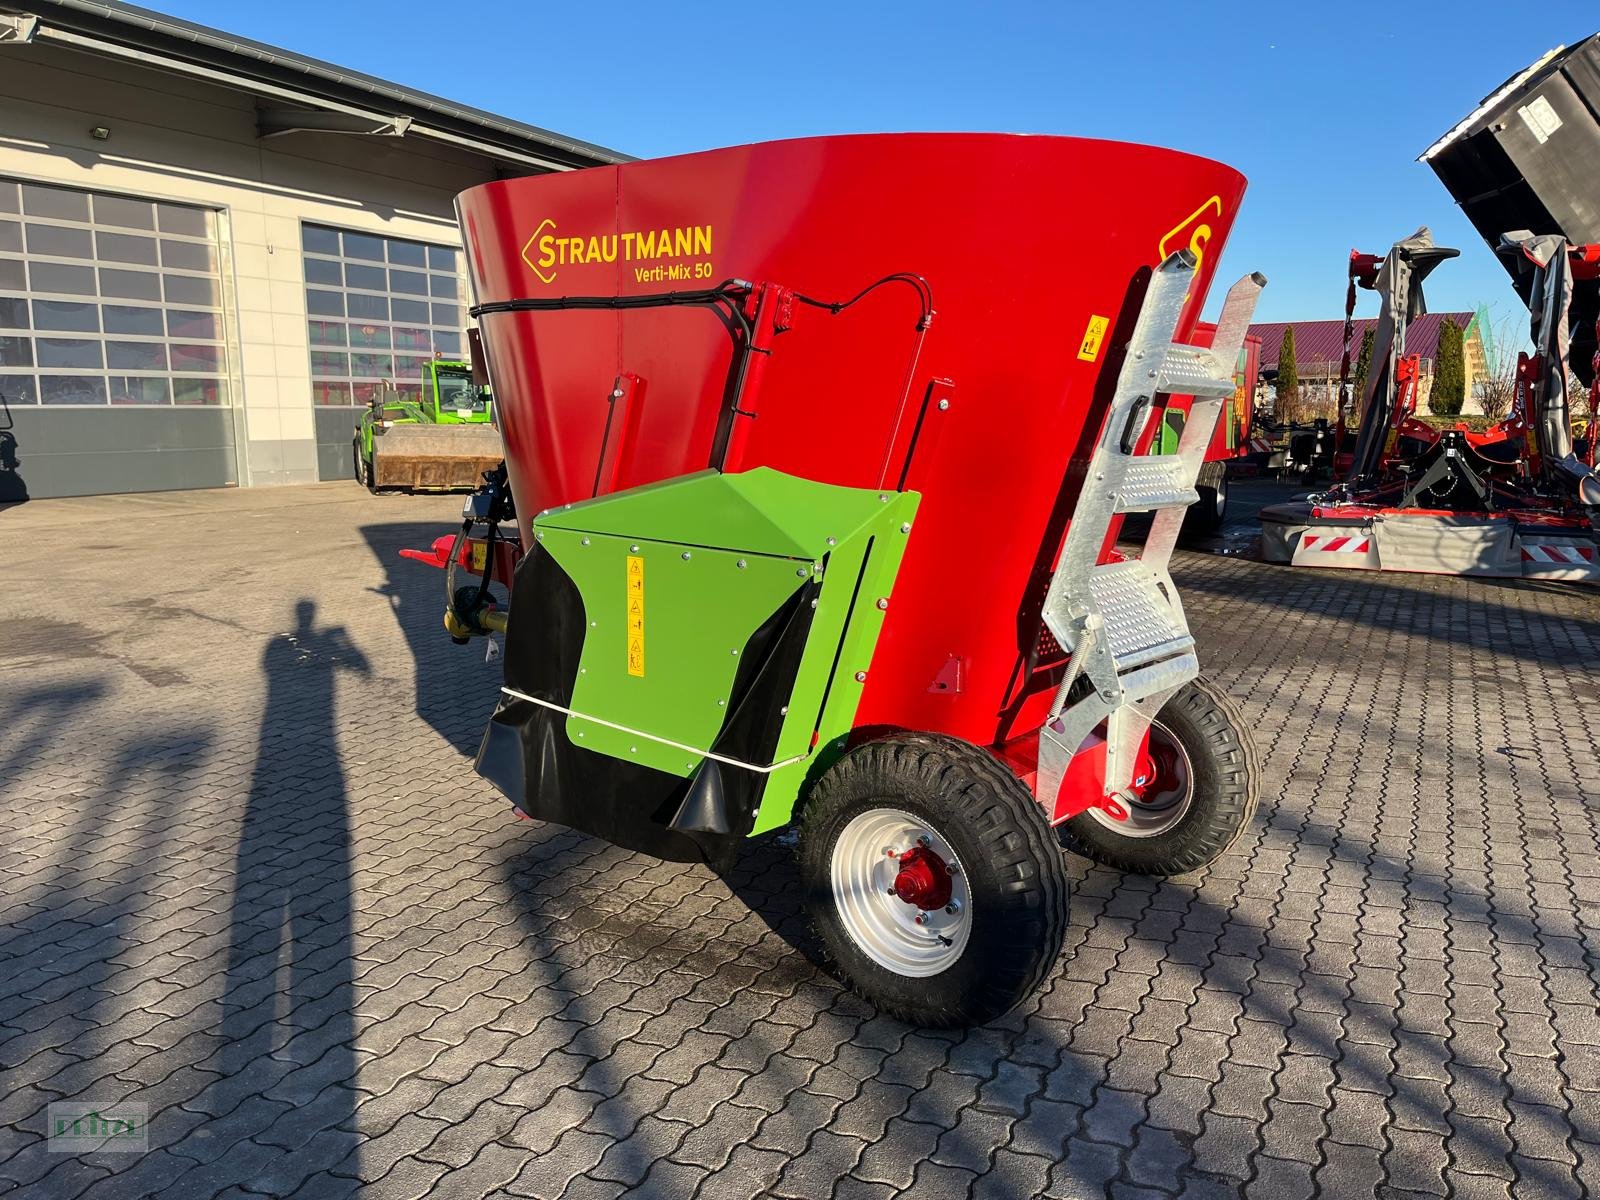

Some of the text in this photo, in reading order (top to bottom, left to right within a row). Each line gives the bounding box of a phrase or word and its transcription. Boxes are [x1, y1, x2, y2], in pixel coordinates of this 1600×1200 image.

[538, 225, 712, 268] STRAUTMANN
[635, 262, 713, 283] Verti-Mix 50
